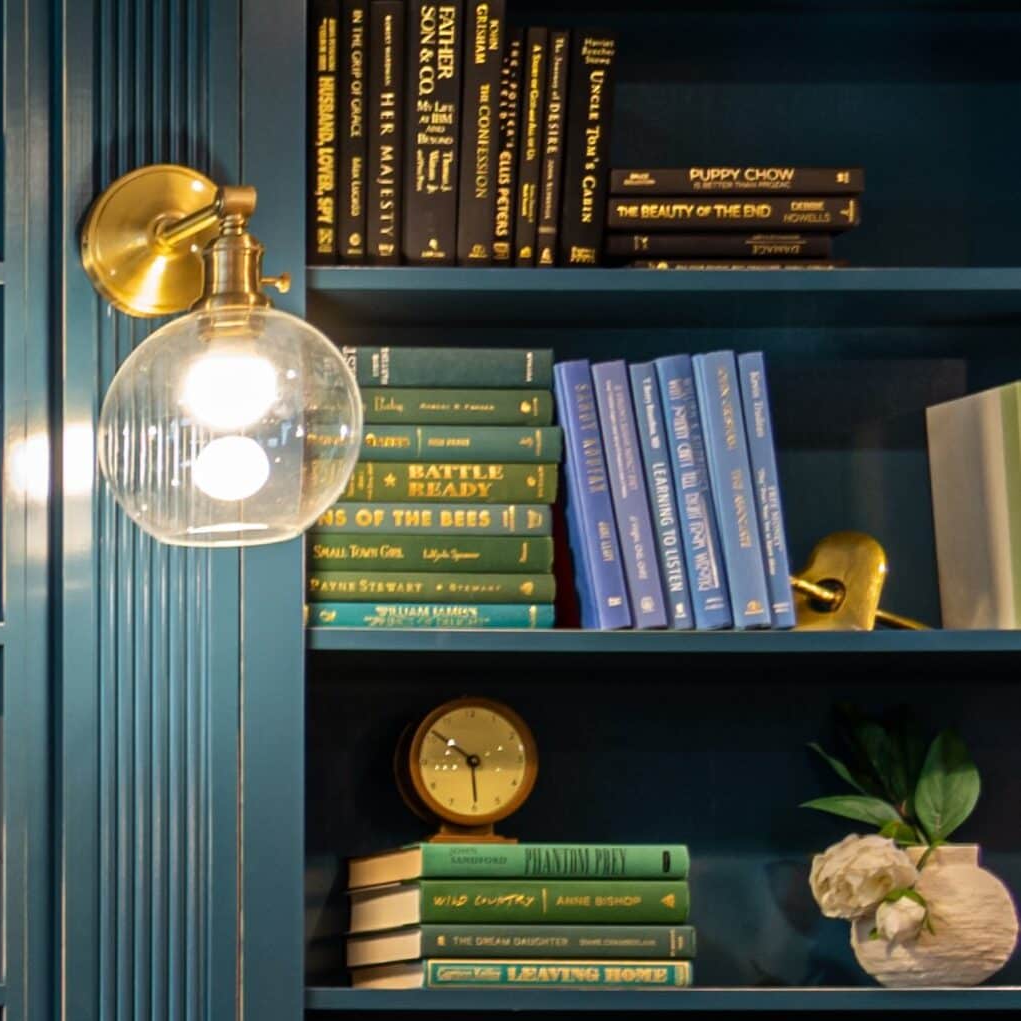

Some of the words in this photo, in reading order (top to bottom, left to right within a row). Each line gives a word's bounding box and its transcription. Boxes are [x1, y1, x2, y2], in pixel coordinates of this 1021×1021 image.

[352, 10, 363, 23] IN
[419, 6, 436, 44] SON
[351, 27, 362, 48] THE
[438, 6, 455, 79] FATHER
[474, 4, 488, 64] GRISHAM
[488, 20, 500, 50] JOHN
[554, 37, 564, 53] The
[351, 50, 362, 78] GRIP
[419, 48, 435, 62] &
[419, 66, 435, 97] CO.
[551, 57, 562, 88] Journey
[480, 84, 490, 102] THE
[552, 91, 560, 100] of
[588, 70, 605, 120] UNCLE
[315, 77, 335, 145] HUSBAND,
[350, 99, 362, 137] GRACE
[380, 93, 394, 135] HER
[547, 102, 561, 154] DESIRE
[475, 105, 491, 198] CONFESSION
[585, 125, 601, 170] TOM'S
[314, 148, 334, 195] LOVER,
[498, 151, 511, 184] ELLIS
[689, 168, 741, 182] PUPPY
[744, 168, 795, 181] CHOW
[377, 145, 394, 236] MAJESTY
[581, 176, 596, 222] CABIN
[317, 197, 334, 222] SPY
[495, 187, 509, 236] PETERS
[616, 206, 638, 217] THE
[640, 205, 694, 218] BEAUTY
[696, 206, 711, 217] OF
[714, 205, 740, 217] THE
[743, 205, 772, 218] END
[783, 213, 830, 223] HOWELLS
[408, 464, 504, 480] BATTLE
[408, 482, 492, 497] READY
[652, 462, 676, 525] LEARNING
[355, 509, 384, 527] OF
[392, 509, 433, 527] THE
[440, 509, 491, 527] BEES
[662, 528, 678, 545] TO
[313, 545, 346, 558] SMALL
[349, 545, 378, 558] TOWN
[380, 545, 404, 558] GIRL
[663, 547, 684, 592] LISTEN
[310, 579, 356, 593] PAYNE
[359, 579, 423, 592] STEWART
[450, 857, 508, 866] SANDFORD
[524, 847, 590, 876] PHANTOM
[594, 847, 627, 876] PREY
[433, 894, 468, 907] WILD
[474, 894, 535, 907] COUNTRY
[556, 895, 591, 906] ANNE
[595, 895, 642, 906] BISHOP
[453, 936, 472, 946] THE
[476, 936, 511, 946] DREAM
[513, 936, 568, 946] DAUGHTER
[507, 966, 600, 982] LEAVING
[604, 966, 668, 982] HOME
